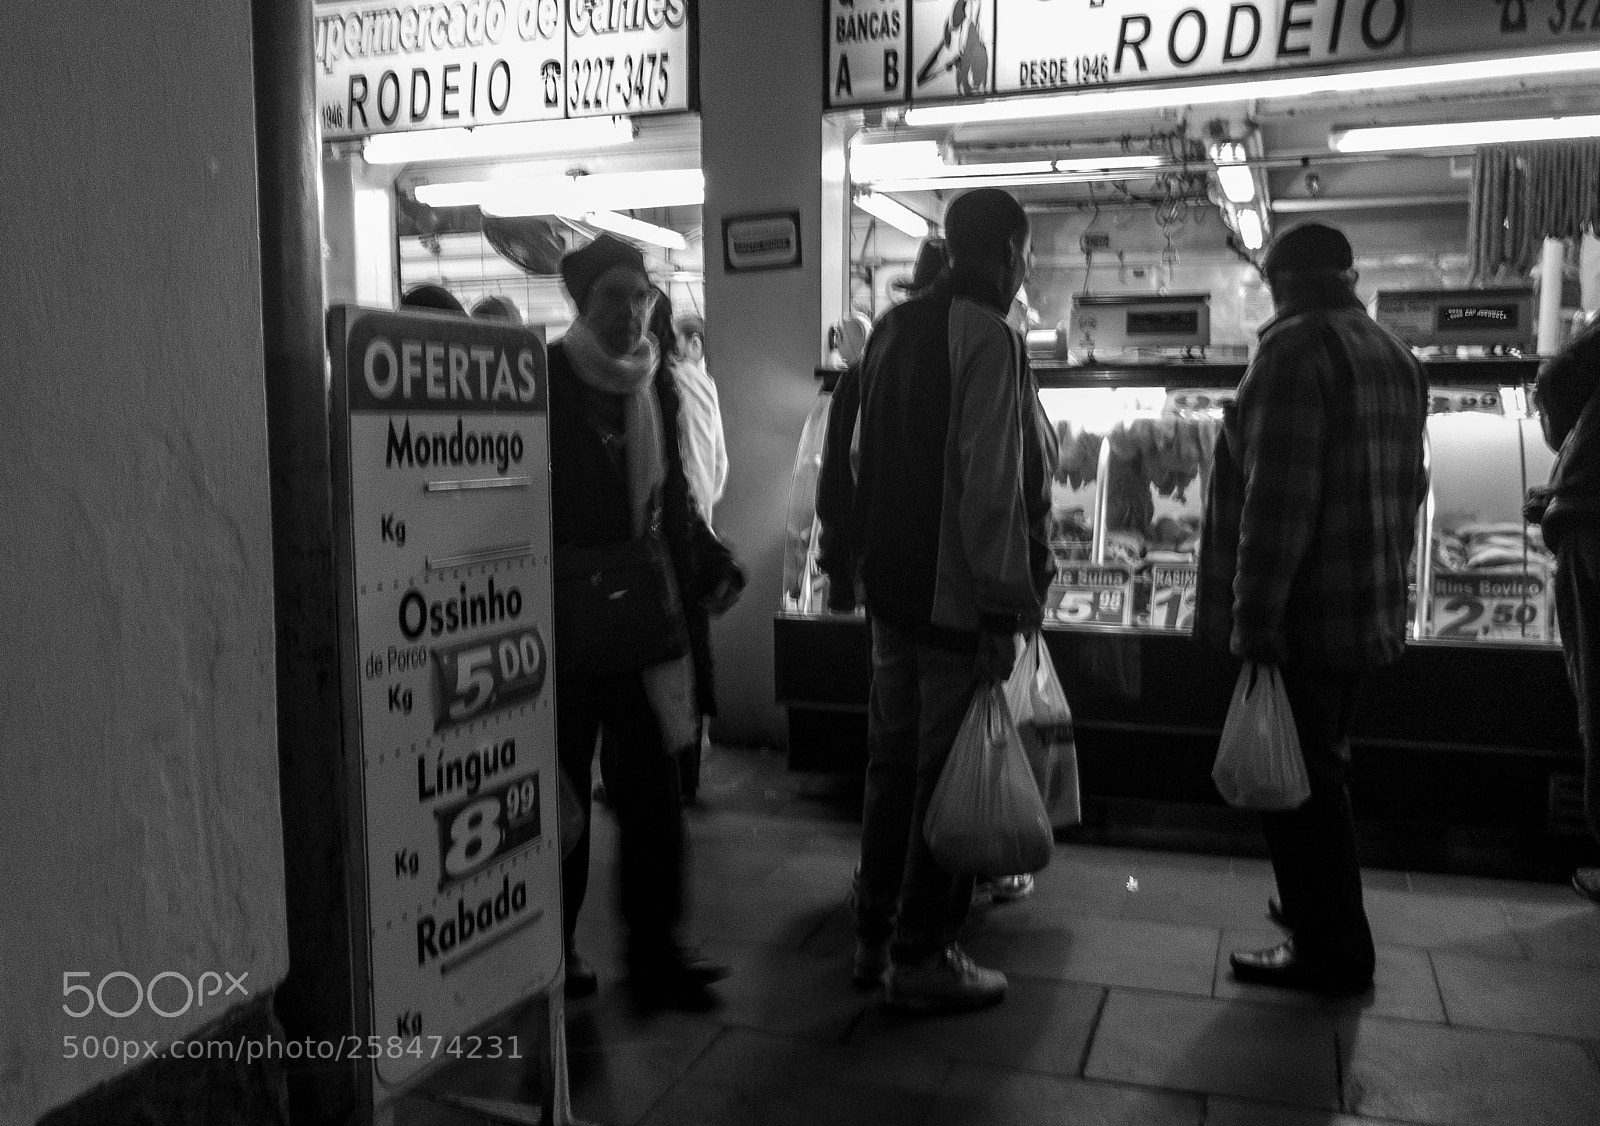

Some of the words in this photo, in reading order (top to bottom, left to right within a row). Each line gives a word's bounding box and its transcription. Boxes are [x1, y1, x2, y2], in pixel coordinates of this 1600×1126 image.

[516, 0, 558, 41] de
[836, 9, 901, 43] BANCAS
[1113, 0, 1404, 74] RODEIO
[347, 58, 511, 130] RODEIO
[569, 50, 669, 112] 3227-3475
[835, 51, 853, 98] A
[883, 48, 899, 93] B
[1019, 58, 1068, 87] DESDE
[1074, 53, 1109, 84] 1946
[363, 335, 537, 403] OFERTAS
[385, 414, 524, 476] Mondongo
[380, 511, 407, 547] Kg
[399, 572, 523, 643] Ossinho
[366, 652, 384, 681] de
[387, 681, 413, 716] Kg
[418, 737, 516, 802] Língua
[394, 847, 419, 879] Kg
[416, 872, 527, 967] Rabada
[397, 1008, 422, 1040] Kg
